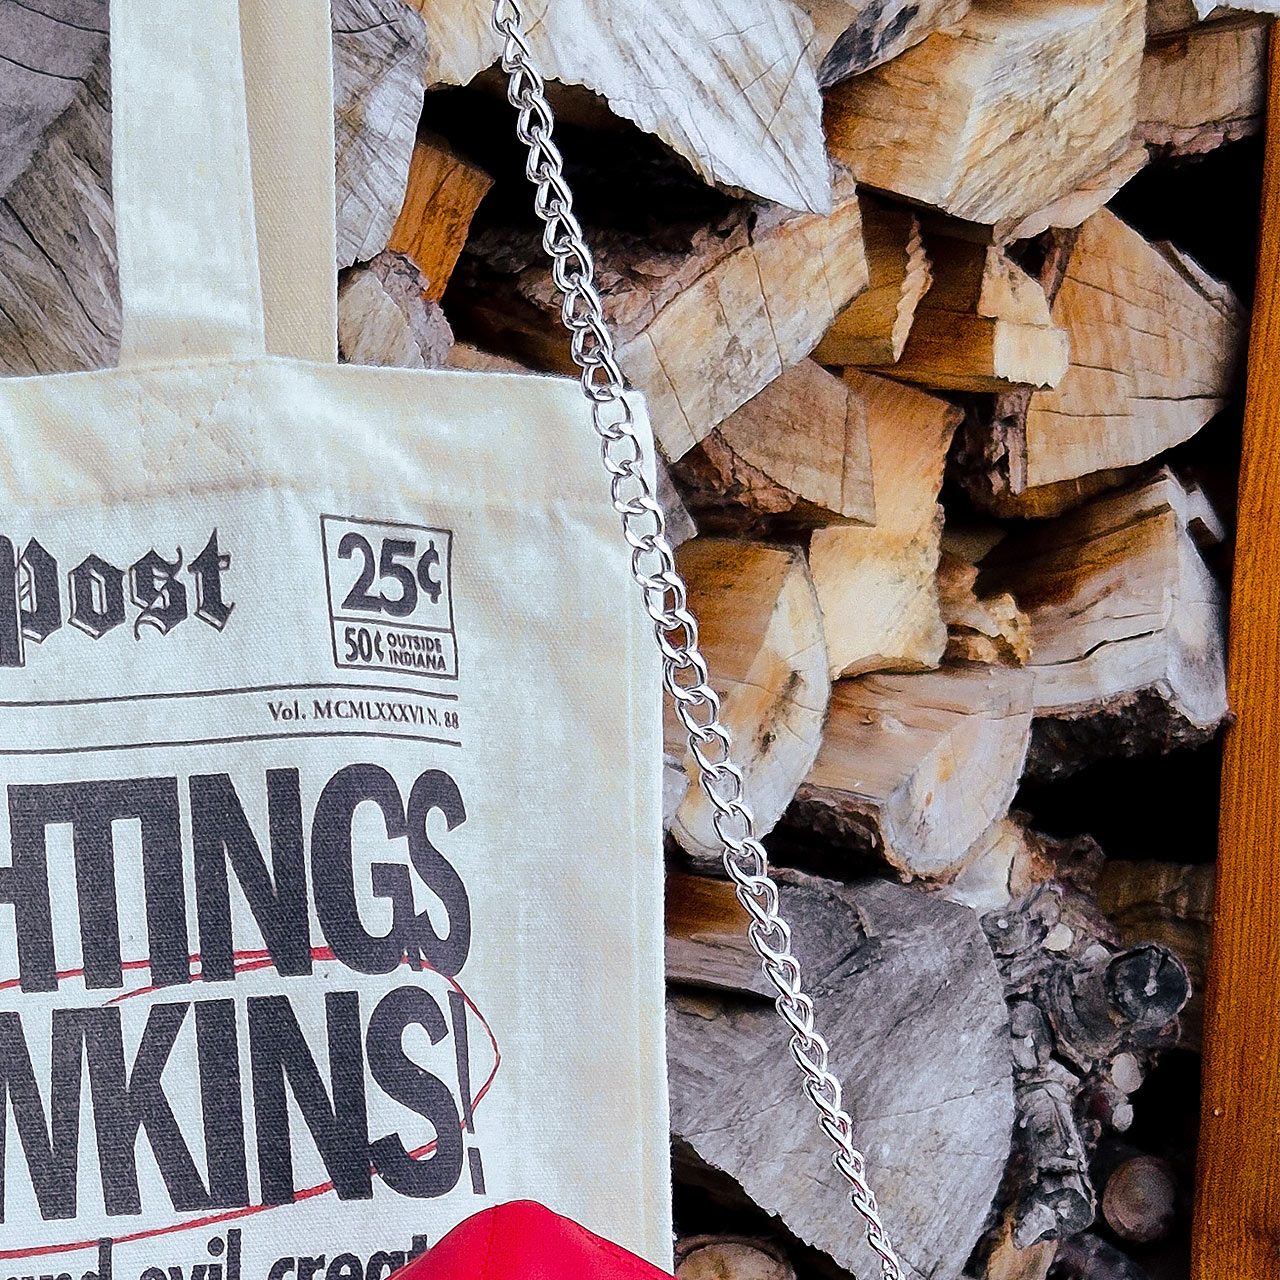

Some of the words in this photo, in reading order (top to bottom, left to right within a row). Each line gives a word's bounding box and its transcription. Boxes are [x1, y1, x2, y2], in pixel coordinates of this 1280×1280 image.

[338, 532, 442, 617] 25¢
[387, 633, 442, 653] OUTSIDE
[389, 650, 446, 670] INDIANA
[267, 700, 307, 721] Vol.
[313, 700, 424, 724] MCMLXXXVI
[444, 711, 460, 729] 88
